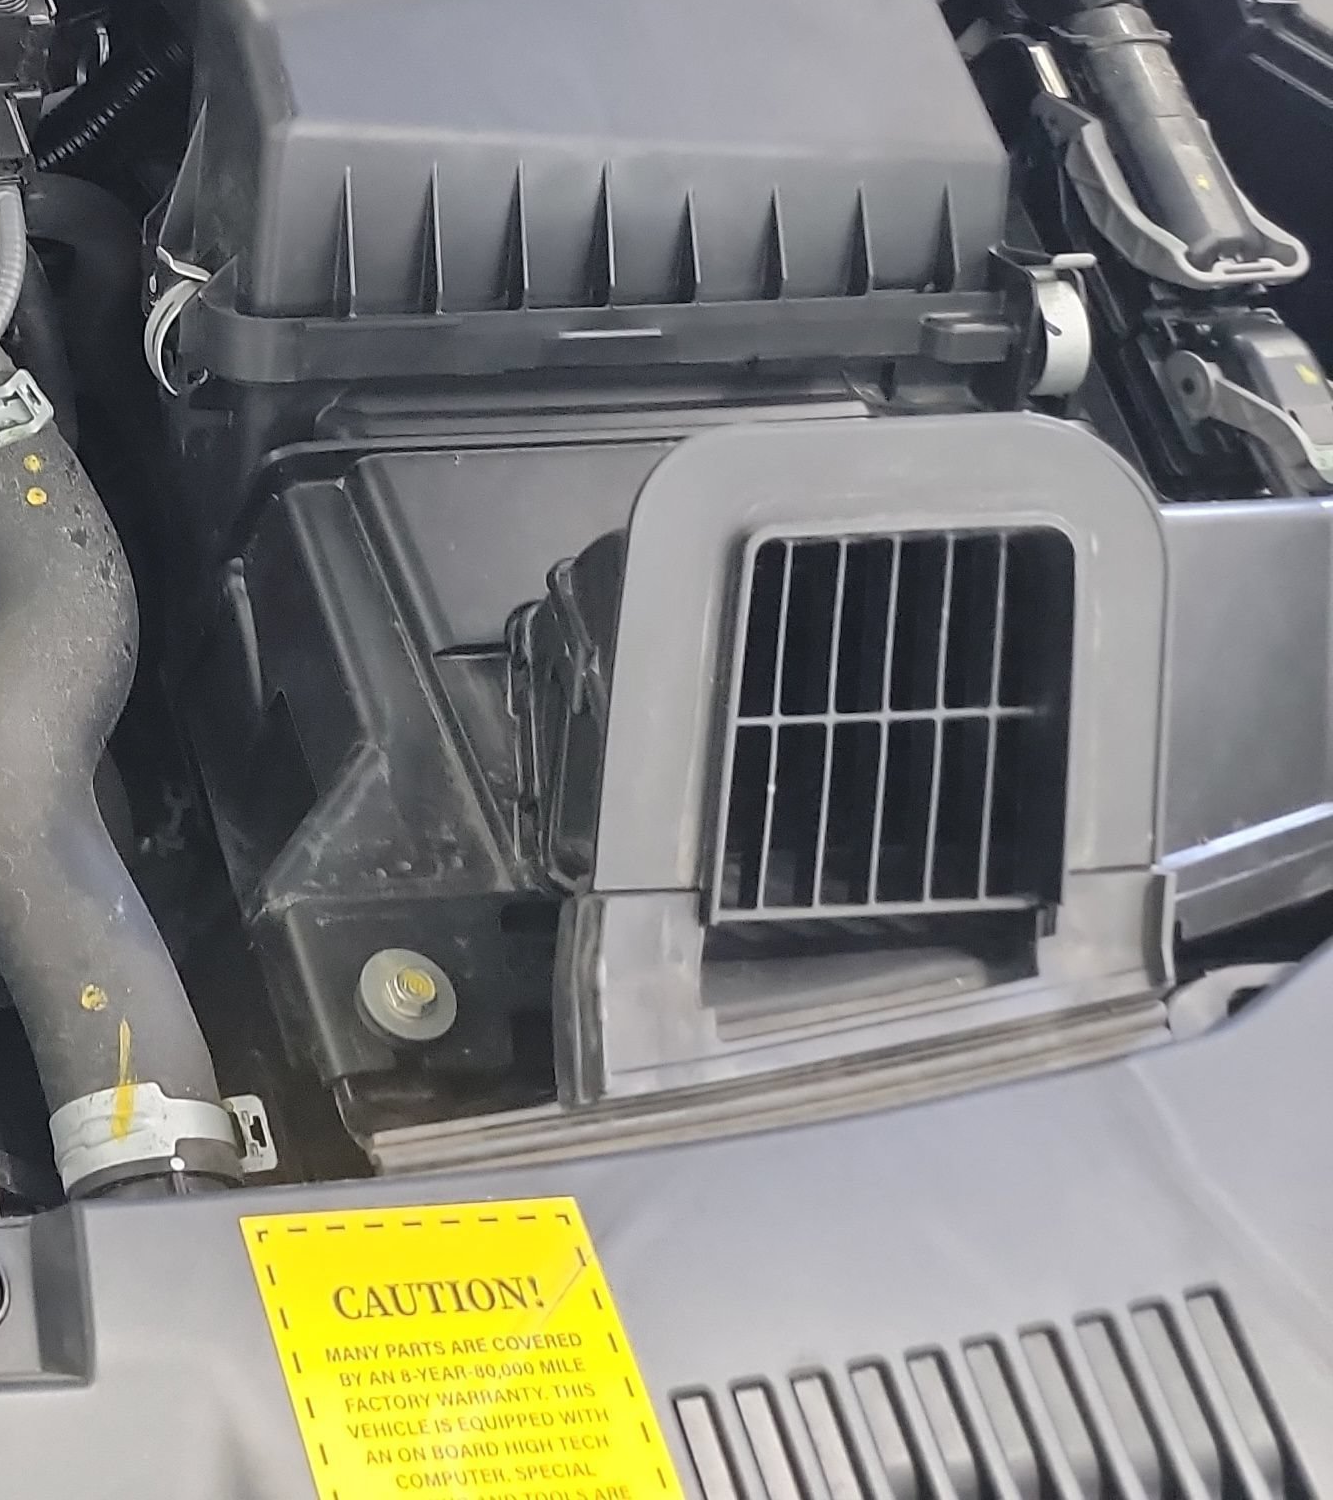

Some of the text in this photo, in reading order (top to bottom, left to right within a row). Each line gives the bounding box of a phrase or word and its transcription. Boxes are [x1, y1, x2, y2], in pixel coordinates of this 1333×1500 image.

[332, 1275, 545, 1320] CAUTION!
[325, 1332, 582, 1363] MANY PARTS ARE COVERED
[339, 1371, 362, 1387] BY
[370, 1369, 396, 1386] AN
[539, 1356, 587, 1375] MILE
[345, 1381, 597, 1414] FACTORY WARRANTY. THIS
[347, 1407, 610, 1440] VEHICLE IS EQUIPPED WITH
[367, 1433, 610, 1466] AN ON BOARD HIGH TECH
[515, 1461, 598, 1483] SPECIAL
[594, 1485, 631, 1500] ARE
